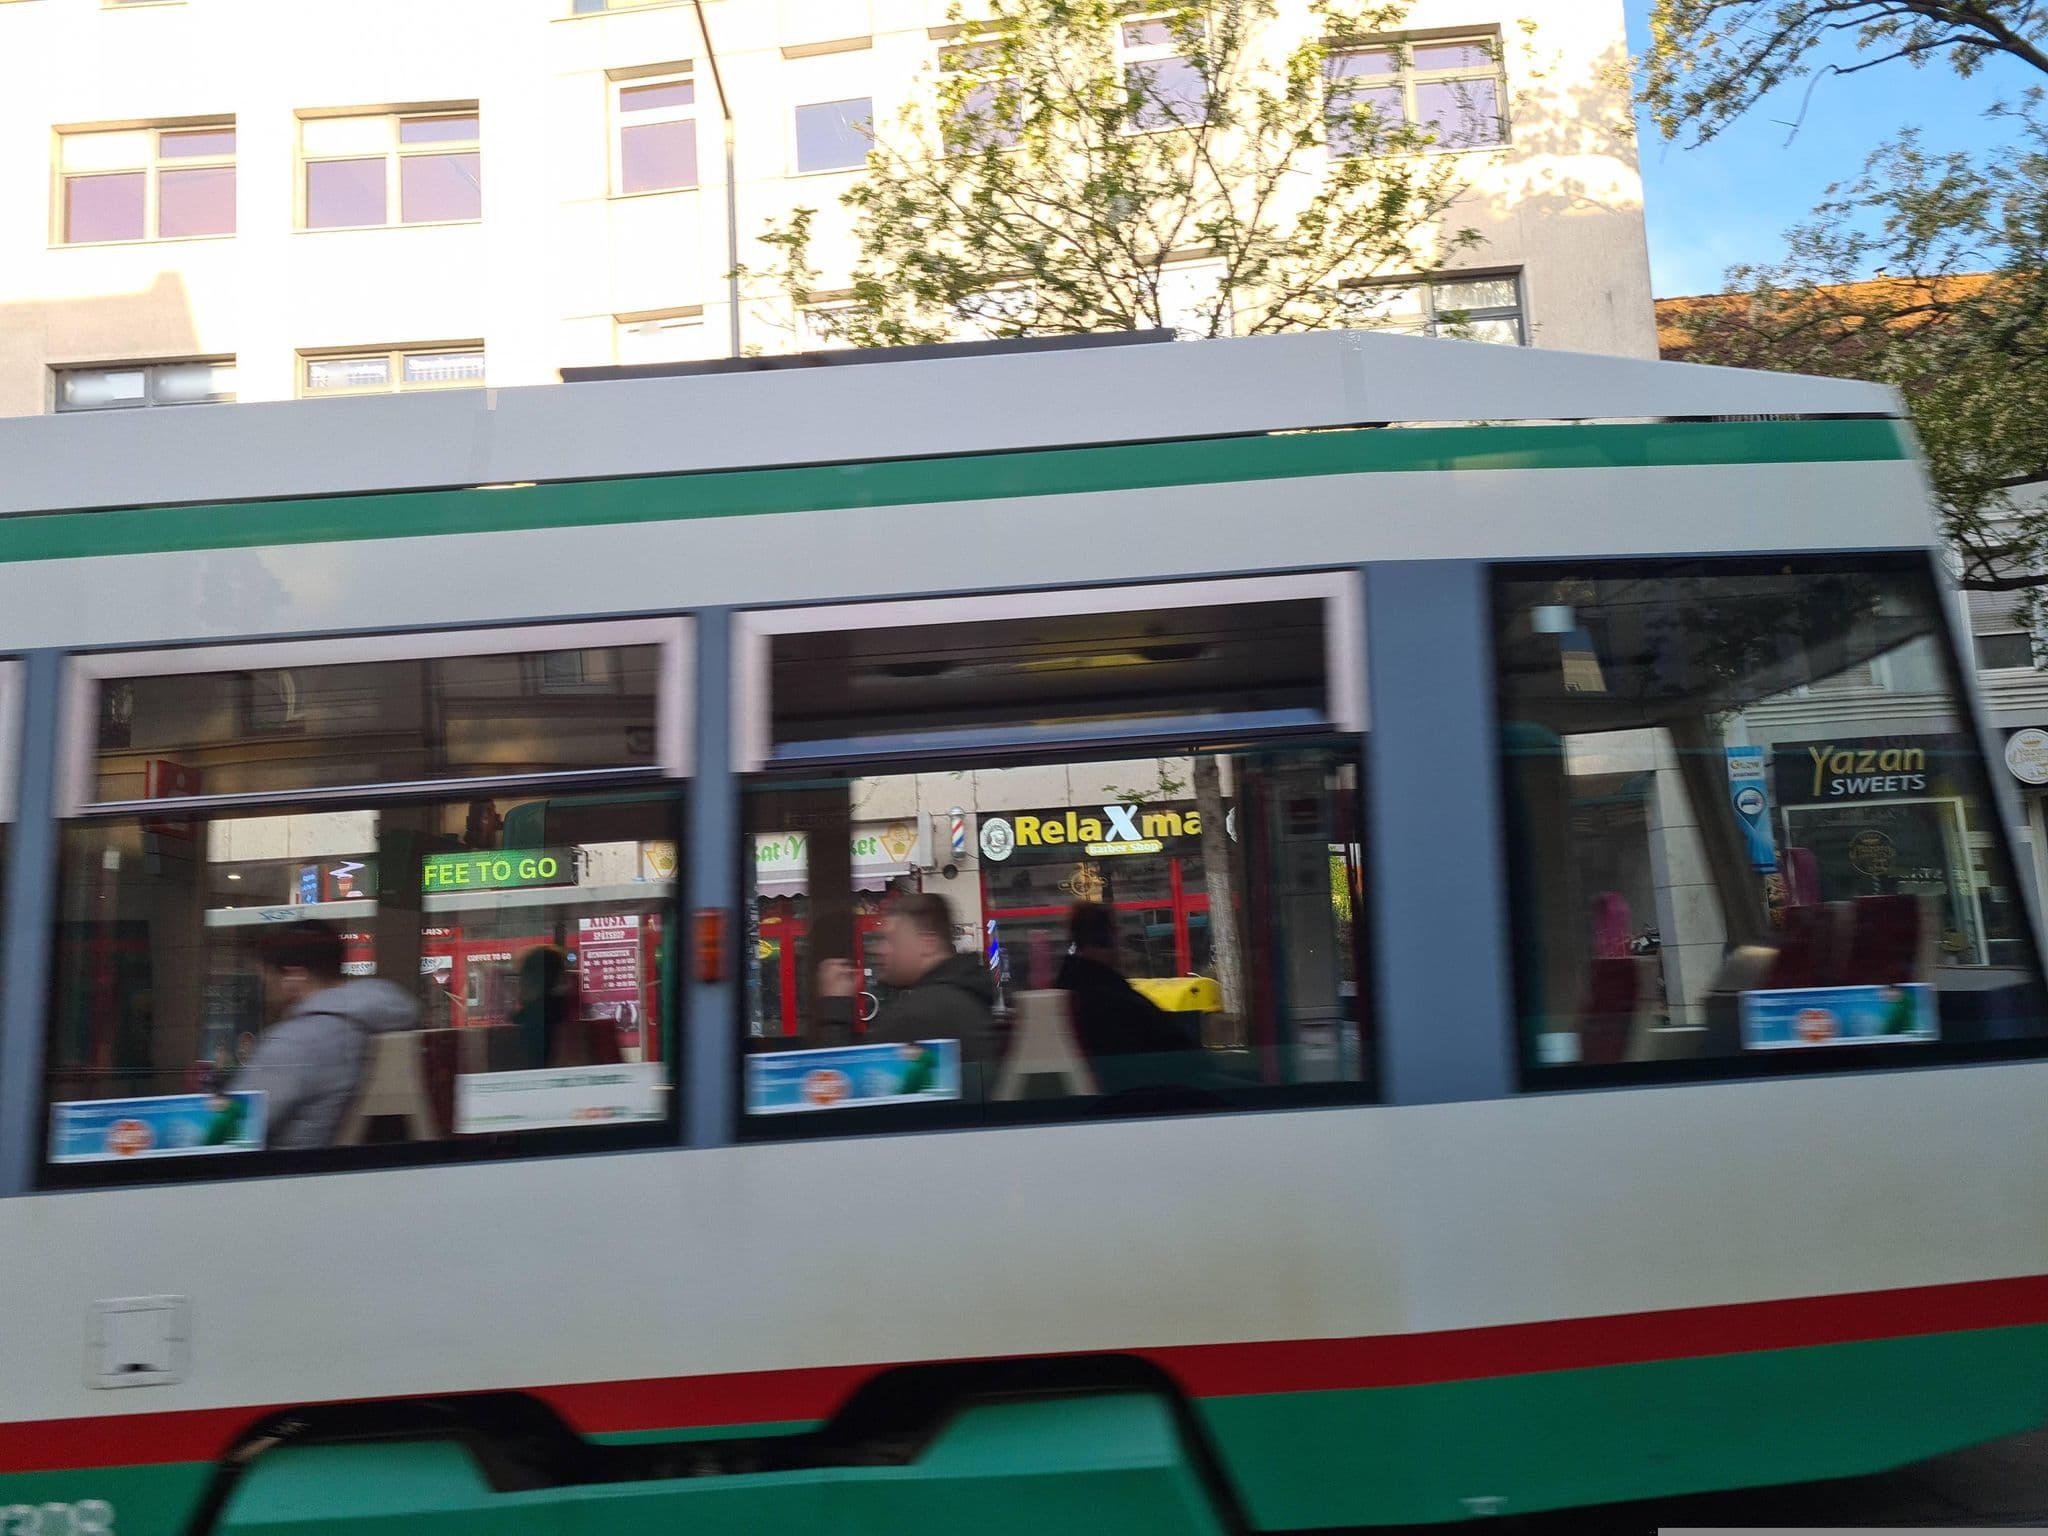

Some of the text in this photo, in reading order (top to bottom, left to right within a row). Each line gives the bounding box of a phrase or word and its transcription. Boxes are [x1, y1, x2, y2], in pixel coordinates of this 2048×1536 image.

[1807, 745, 1925, 796] Yazan
[1830, 774, 1926, 795] SWEETS
[477, 860, 512, 881] TO
[518, 857, 557, 879] GO
